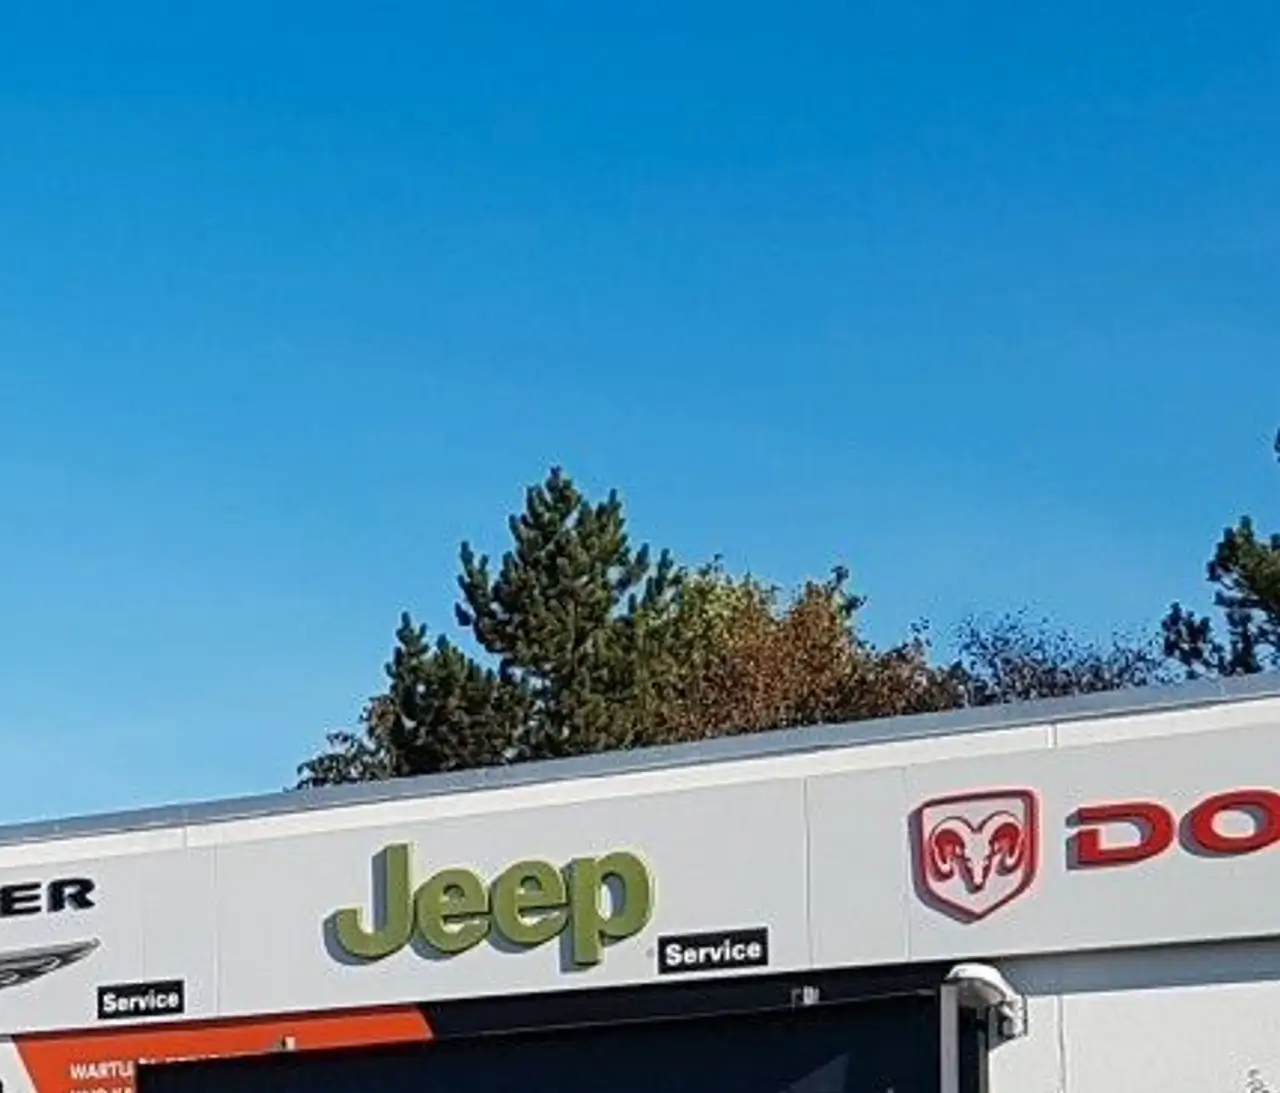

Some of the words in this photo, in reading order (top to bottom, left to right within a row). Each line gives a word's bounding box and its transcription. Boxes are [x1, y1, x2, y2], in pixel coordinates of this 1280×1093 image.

[1066, 790, 1280, 866] DO
[330, 843, 650, 968] Jeep
[665, 938, 763, 966] Service
[102, 988, 180, 1014] Service
